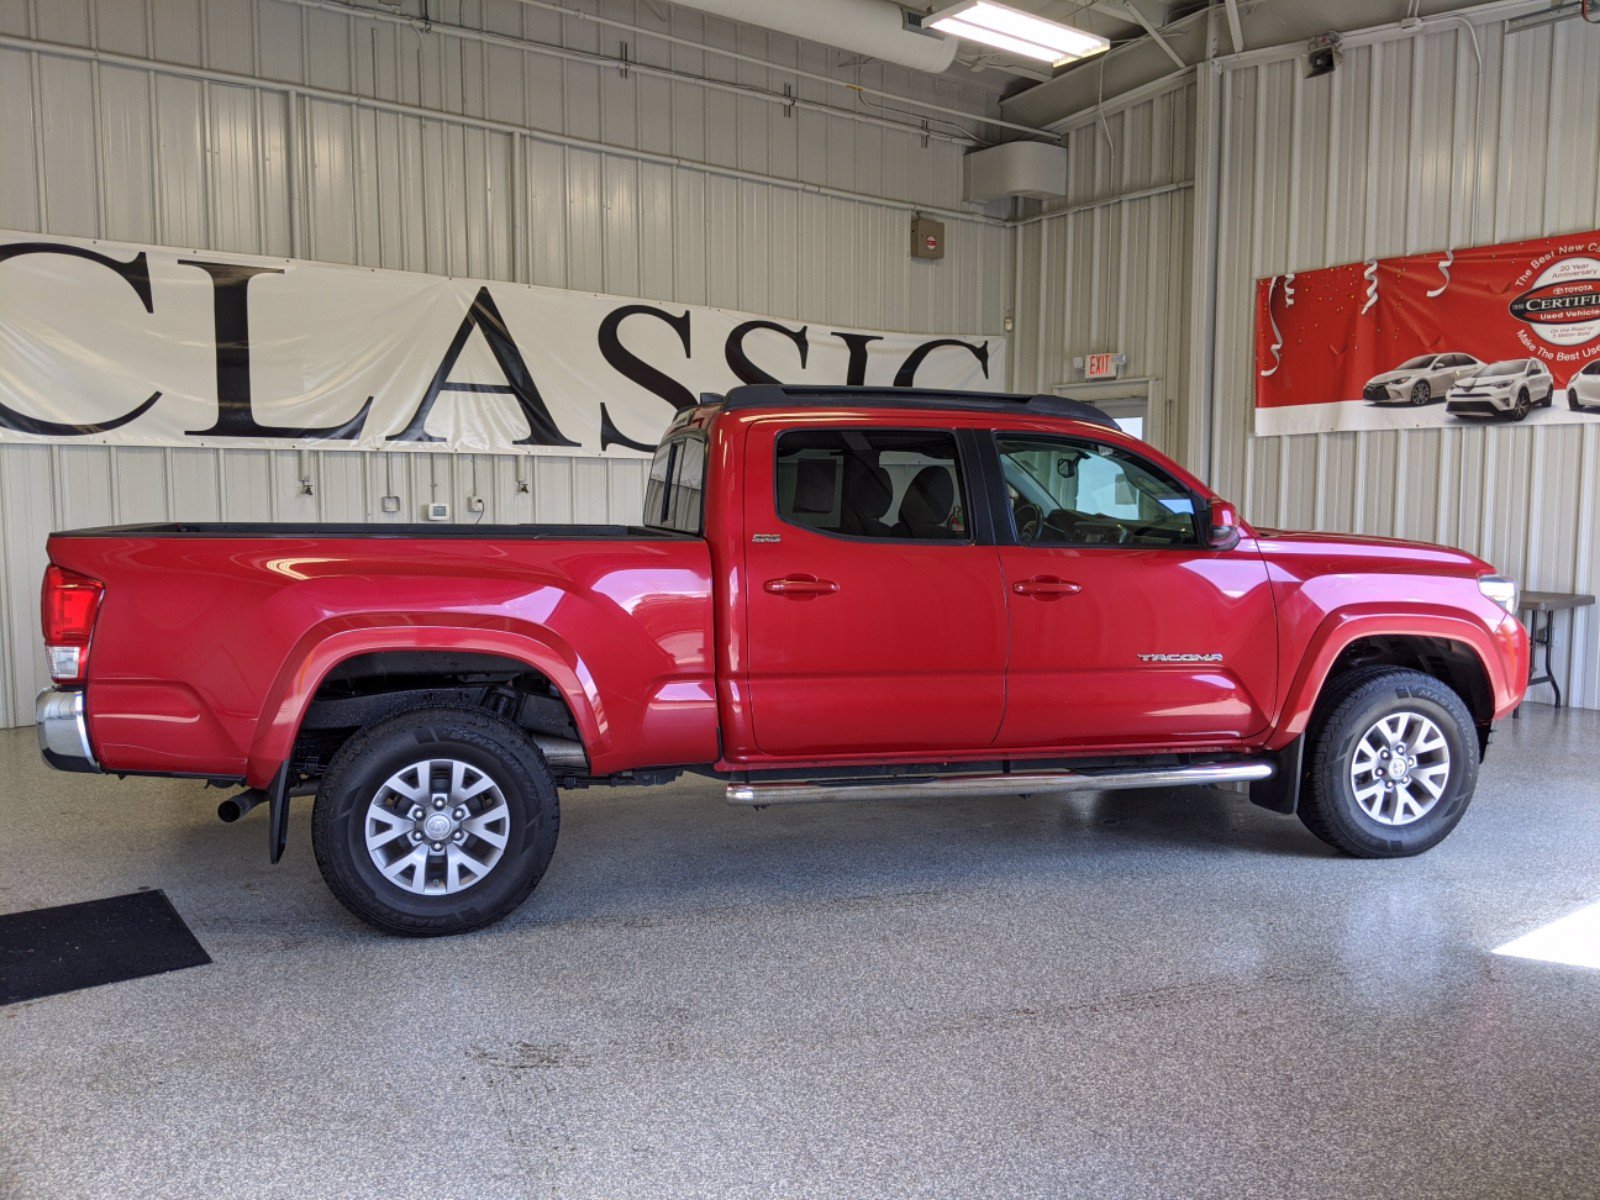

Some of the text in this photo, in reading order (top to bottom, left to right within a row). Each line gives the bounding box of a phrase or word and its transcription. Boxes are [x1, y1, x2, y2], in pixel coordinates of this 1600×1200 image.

[1514, 268, 1533, 286] The
[1530, 250, 1555, 269] Best
[1558, 244, 1584, 254] New
[1552, 269, 1597, 279] Anniversary
[1564, 284, 1593, 293] TOYOTA
[1526, 294, 1600, 310] CERTIFI
[1540, 311, 1563, 320] Used
[1516, 329, 1536, 351] Make
[1537, 346, 1554, 359] The
[1556, 351, 1580, 361] Best
[1089, 353, 1110, 375] EXIT
[1136, 653, 1223, 662] TACOMA
